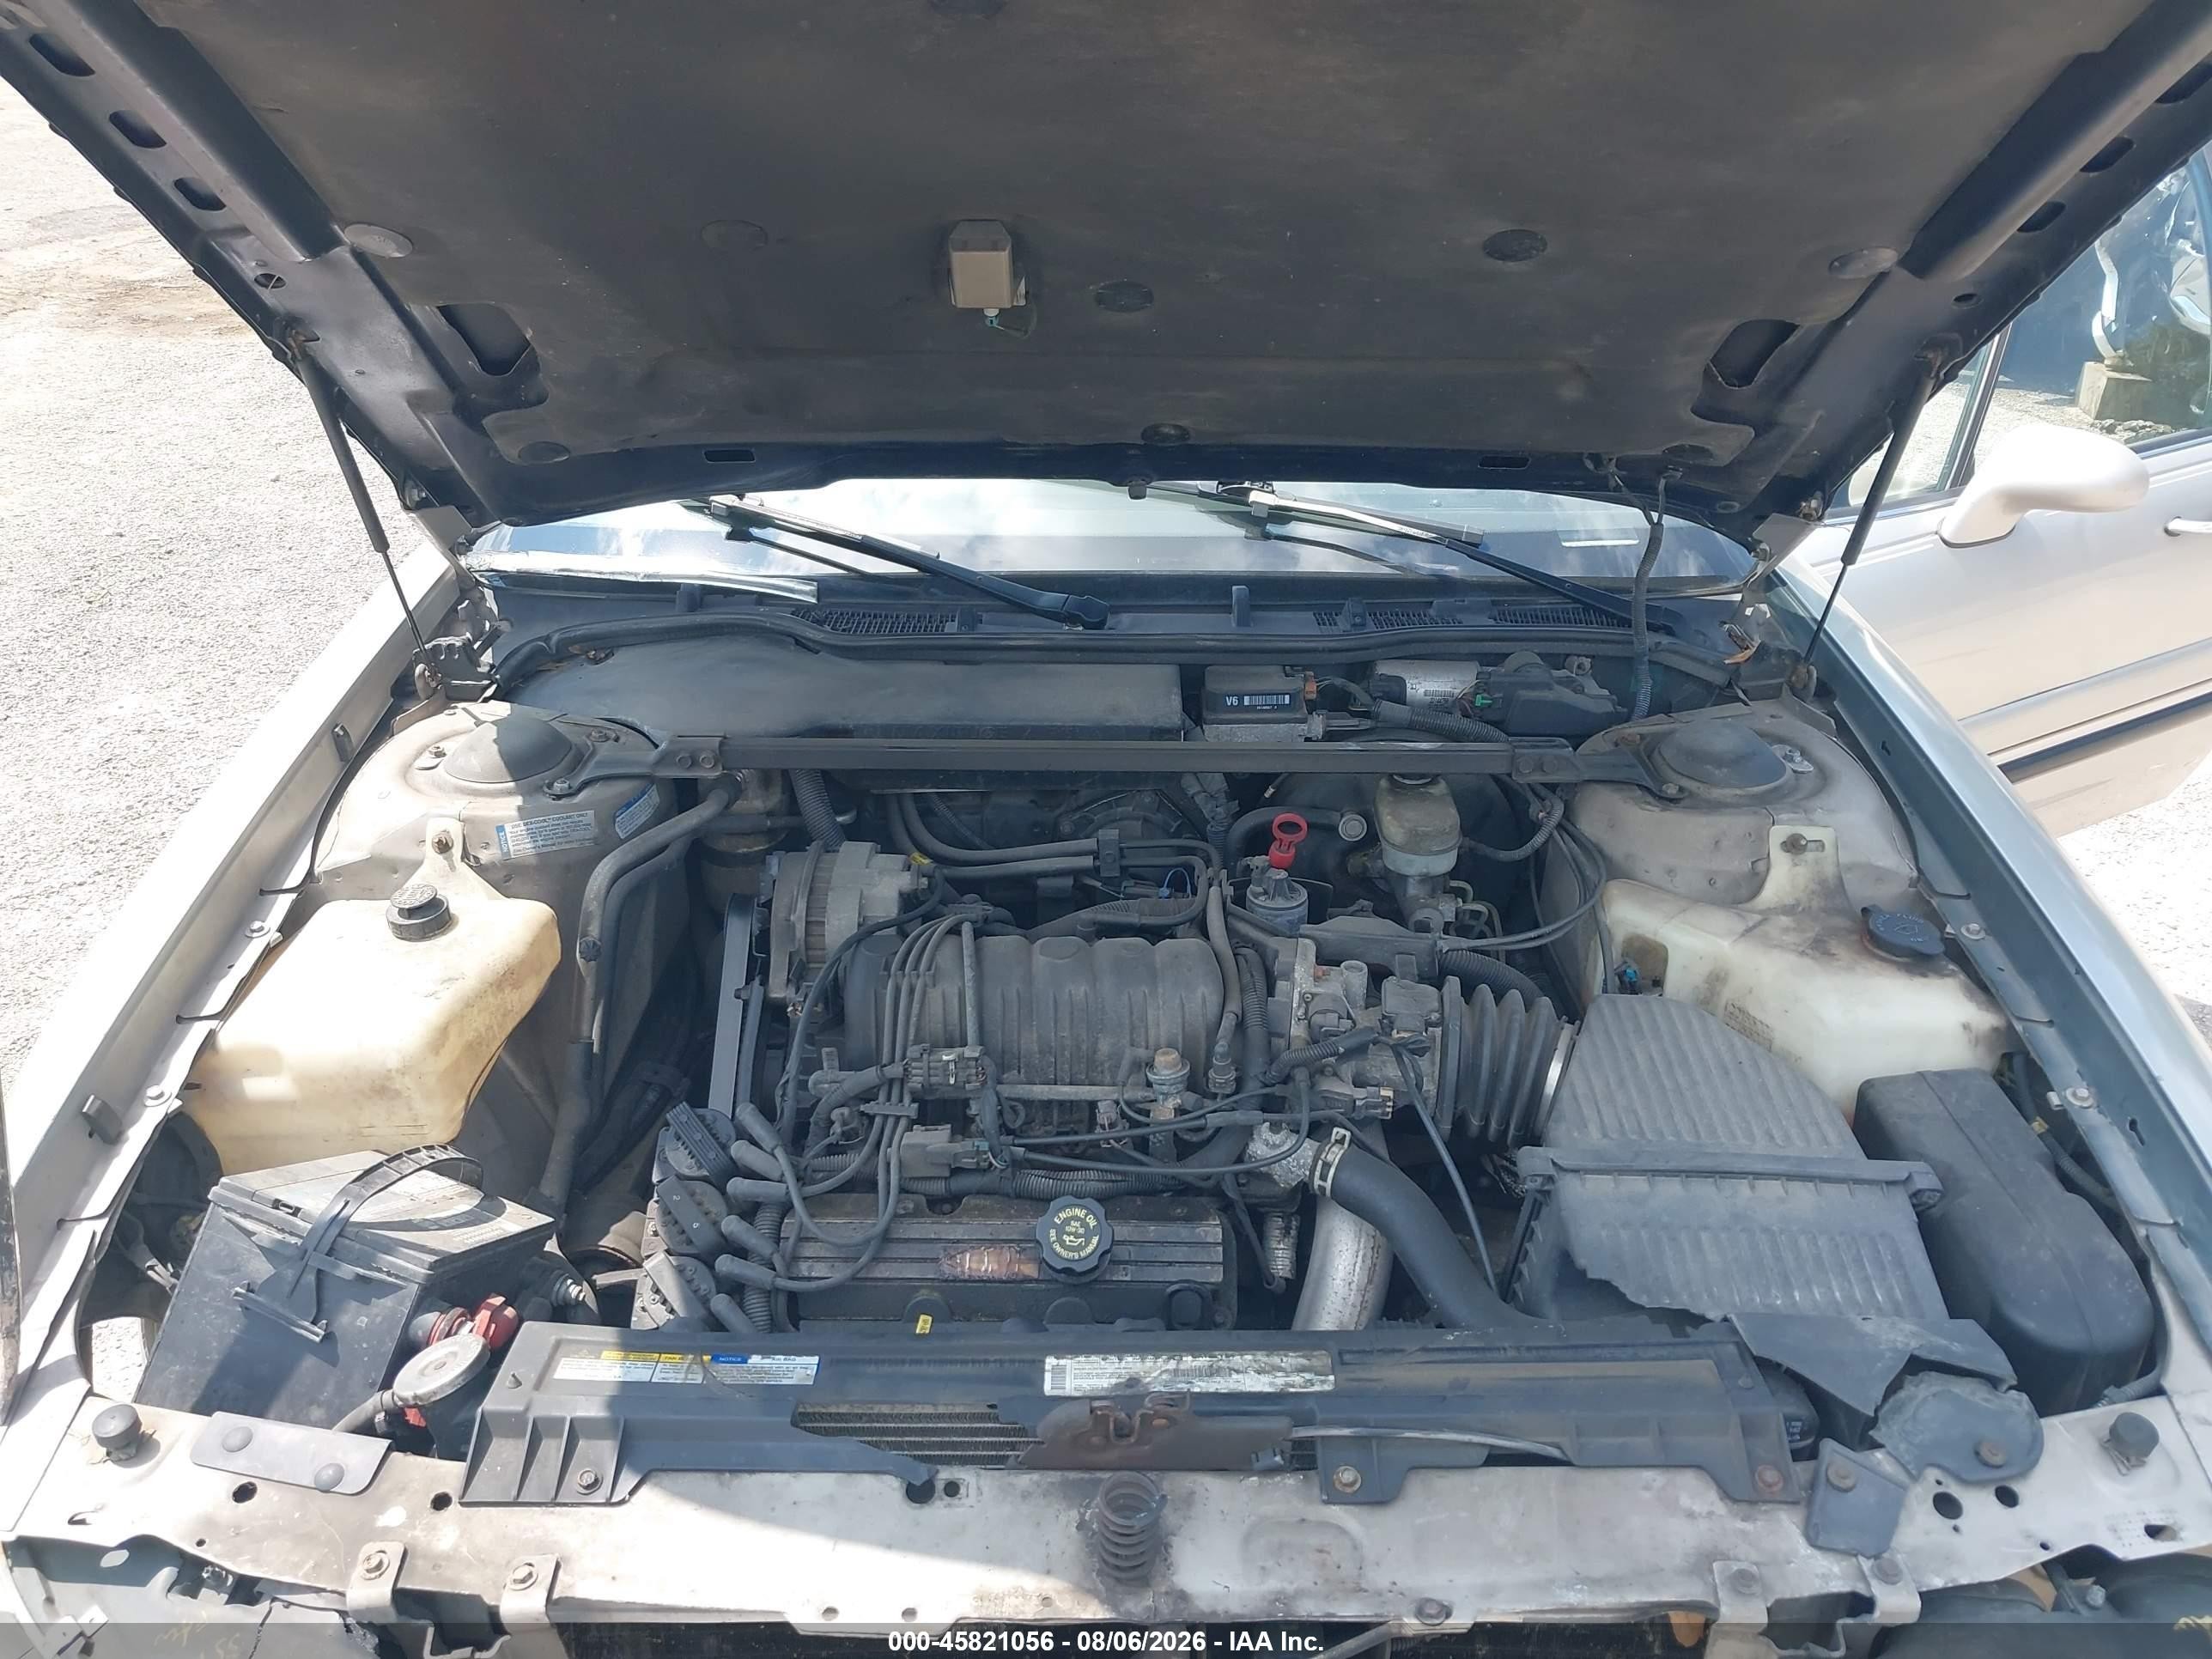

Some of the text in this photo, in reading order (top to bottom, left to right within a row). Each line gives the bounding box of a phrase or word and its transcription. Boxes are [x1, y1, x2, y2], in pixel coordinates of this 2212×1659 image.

[1225, 696, 1239, 706] V6
[499, 830, 508, 853] NOTICE
[1054, 1207, 1097, 1230] ENGINE OIL
[1079, 1234, 1100, 1257] MANUAL
